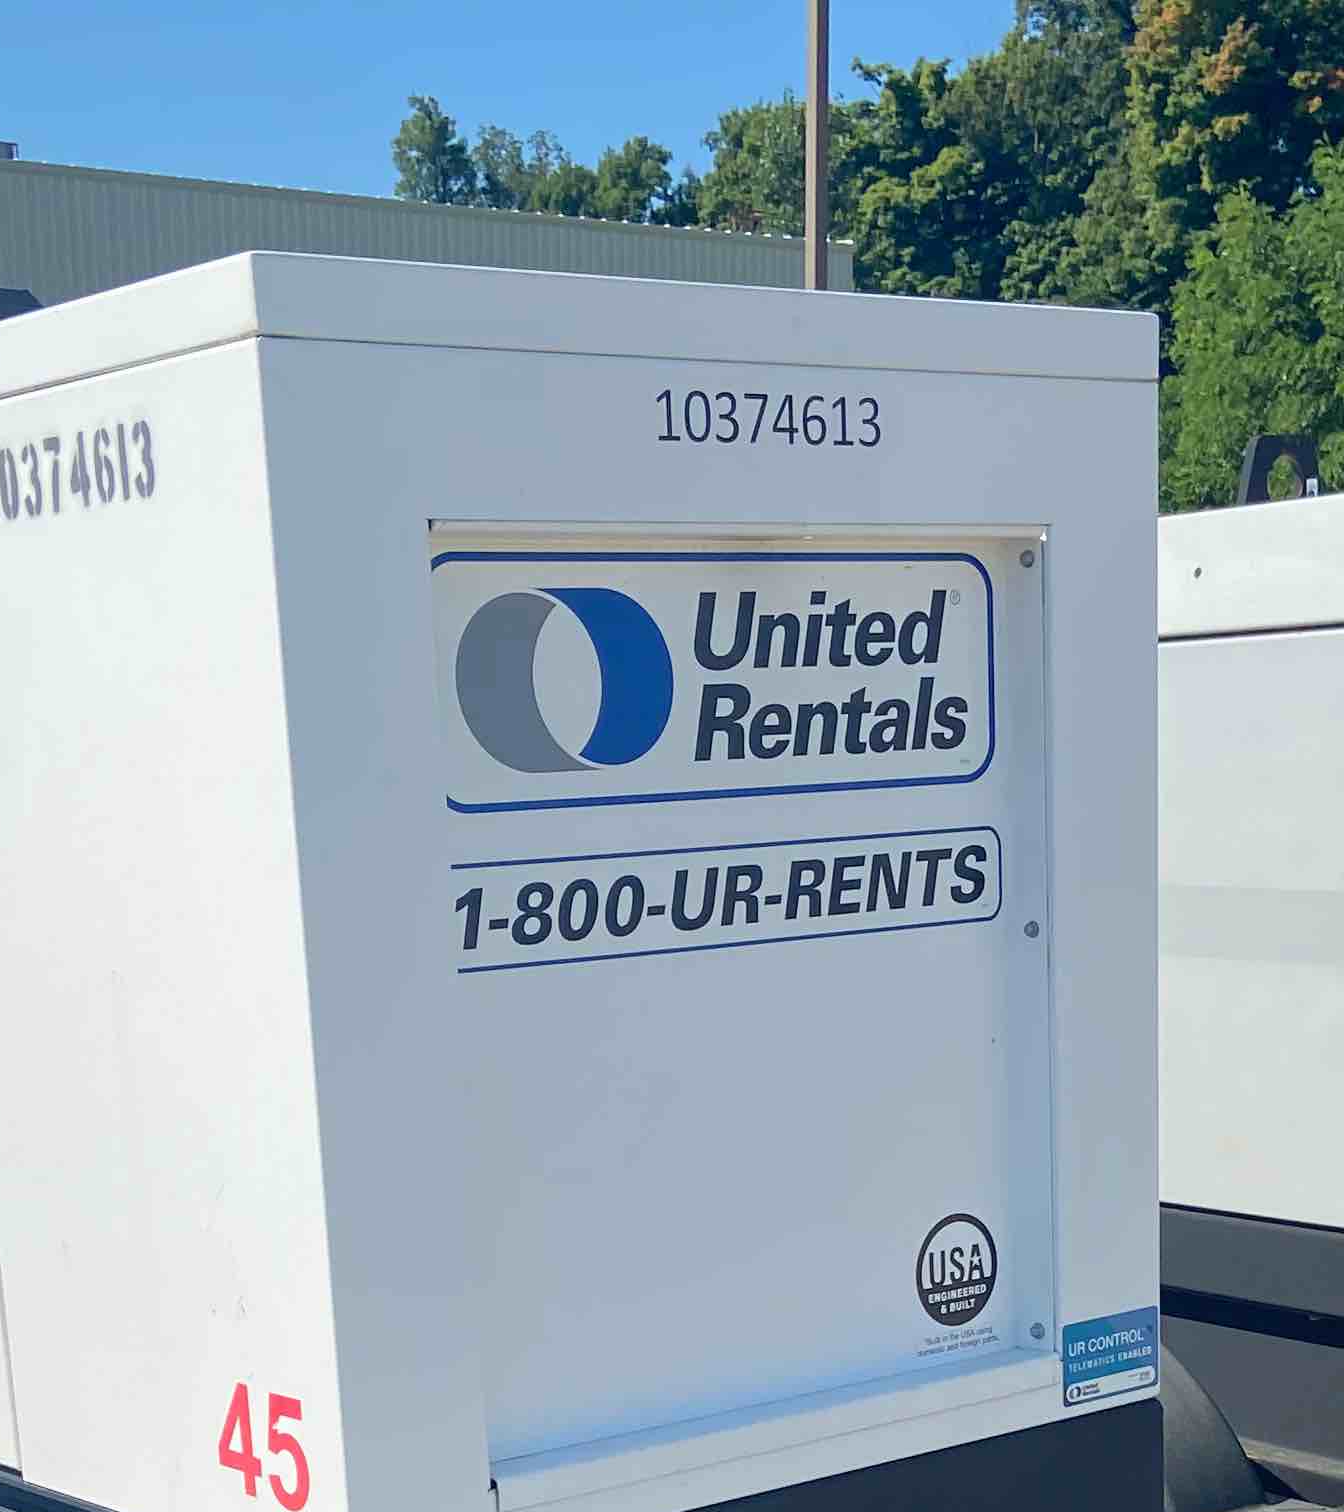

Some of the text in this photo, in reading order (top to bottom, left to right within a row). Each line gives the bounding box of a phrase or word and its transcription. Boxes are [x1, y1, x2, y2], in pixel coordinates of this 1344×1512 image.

[656, 389, 882, 447] 10374613
[693, 589, 947, 671] United
[693, 676, 969, 762] Rentals
[453, 844, 988, 951] 1-800-UR-RENTS
[928, 1283, 988, 1305] ENGINEERED
[929, 1243, 986, 1287] USA
[949, 1298, 976, 1313] BUILT
[1068, 1328, 1145, 1358] UR CONTROL
[218, 1381, 310, 1512] 45
